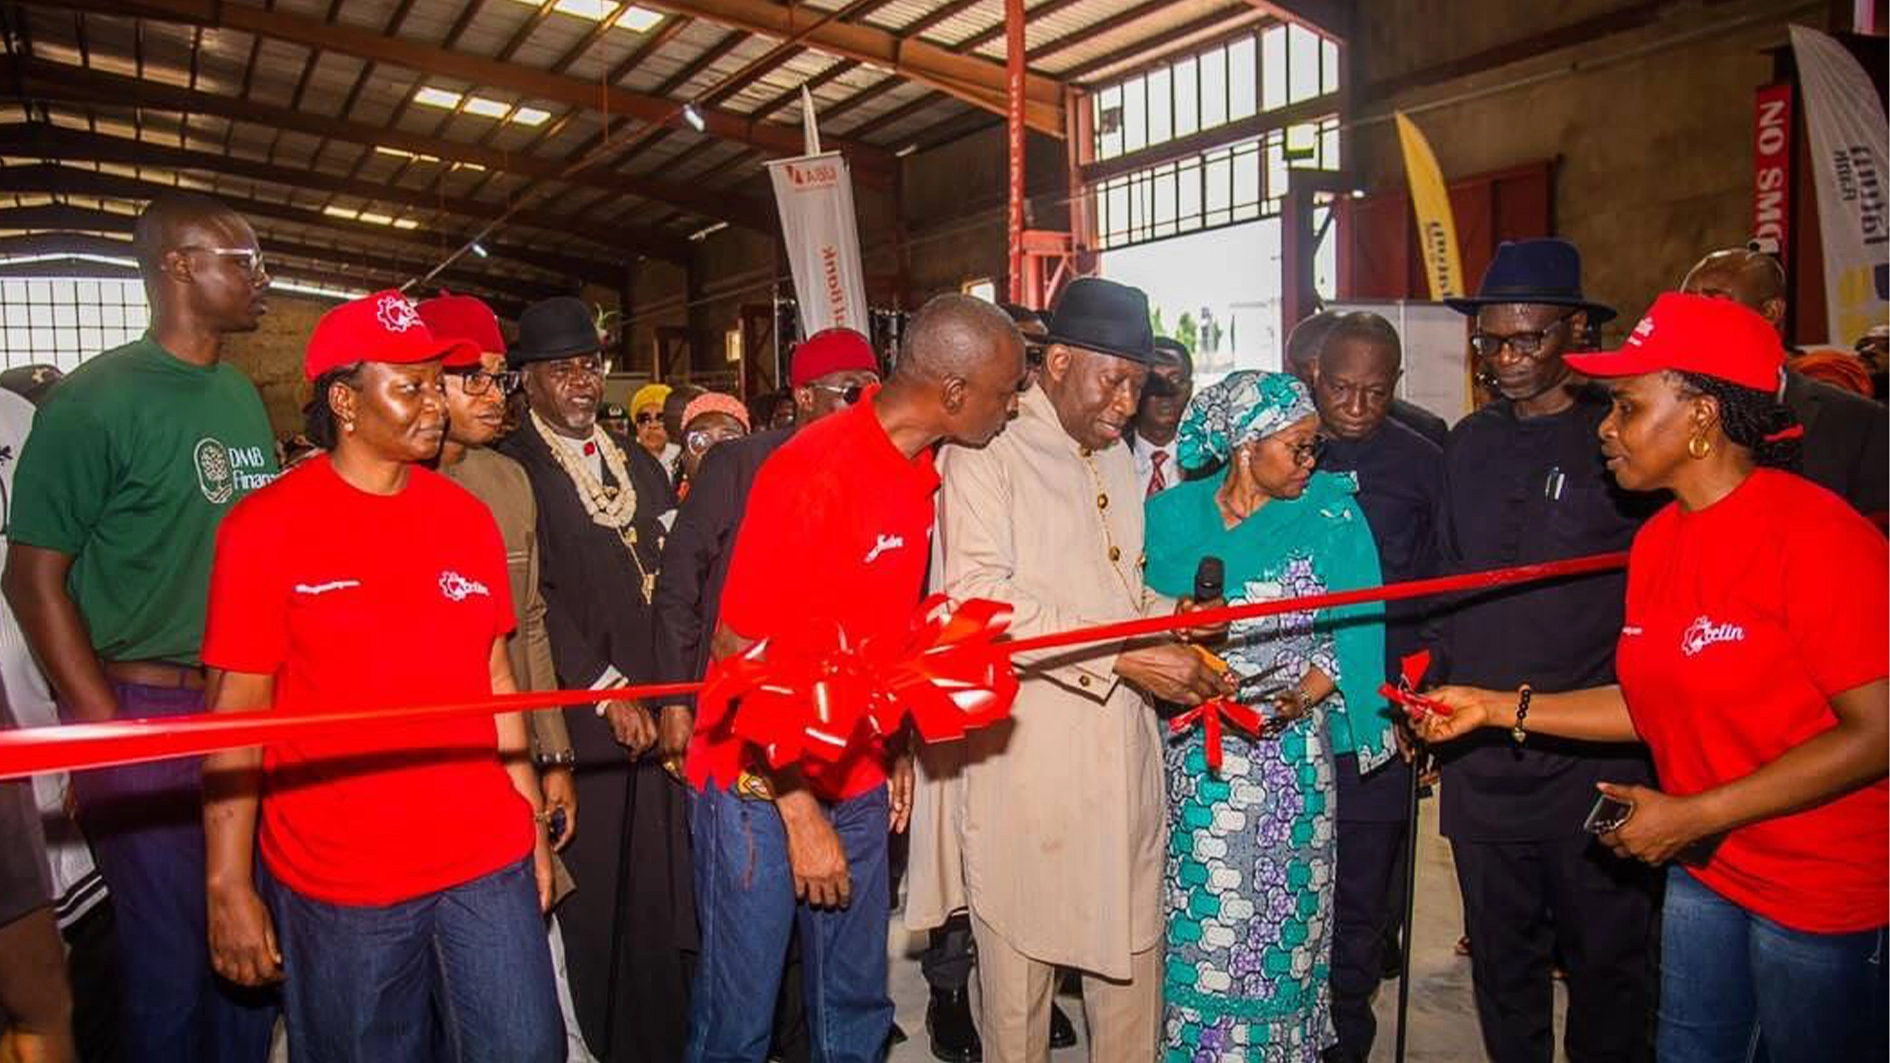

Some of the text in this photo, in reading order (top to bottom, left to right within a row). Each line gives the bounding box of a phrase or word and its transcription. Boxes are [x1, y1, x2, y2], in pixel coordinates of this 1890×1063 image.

[1759, 100, 1785, 155] NO
[228, 446, 265, 468] DMB
[233, 469, 275, 489] Finan
